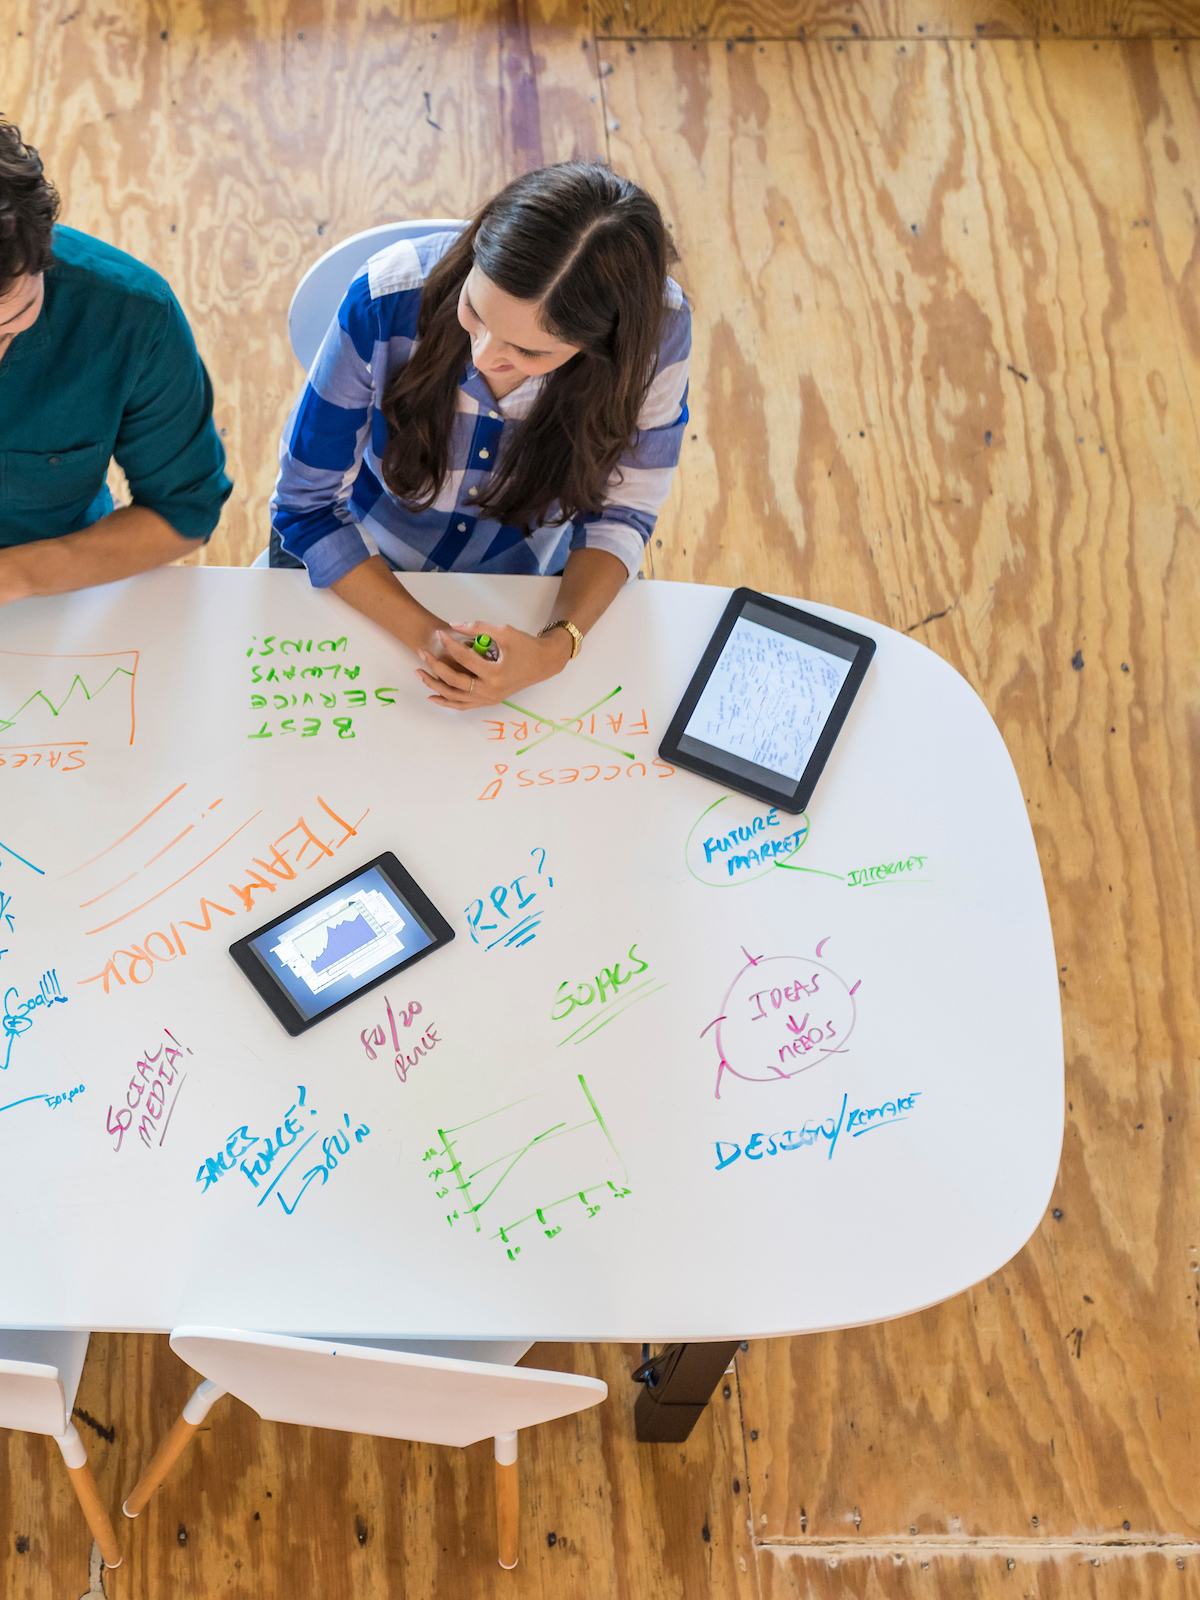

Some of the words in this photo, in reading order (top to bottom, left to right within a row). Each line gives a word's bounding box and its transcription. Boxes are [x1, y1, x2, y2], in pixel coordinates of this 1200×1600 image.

[246, 635, 348, 658] WINS!
[248, 687, 399, 710] SERVICE
[251, 663, 360, 684] ALWAYS
[247, 716, 356, 740] BEST
[481, 708, 649, 741] FAILURE
[477, 756, 676, 801] SUCCESS!
[703, 807, 780, 863] FUTURE
[727, 827, 808, 876] MARKET
[76, 795, 370, 994] TEAMWORK
[464, 847, 554, 944] RPI?
[847, 856, 928, 887] INTERNET
[551, 943, 649, 1021] GOALS
[748, 974, 819, 1021] IDEAS
[360, 995, 422, 1060] 80/20
[394, 1022, 442, 1083] RULE
[106, 1042, 164, 1153] SOCIAL
[138, 1028, 194, 1149] MEDIA!
[195, 1125, 260, 1194] SALES
